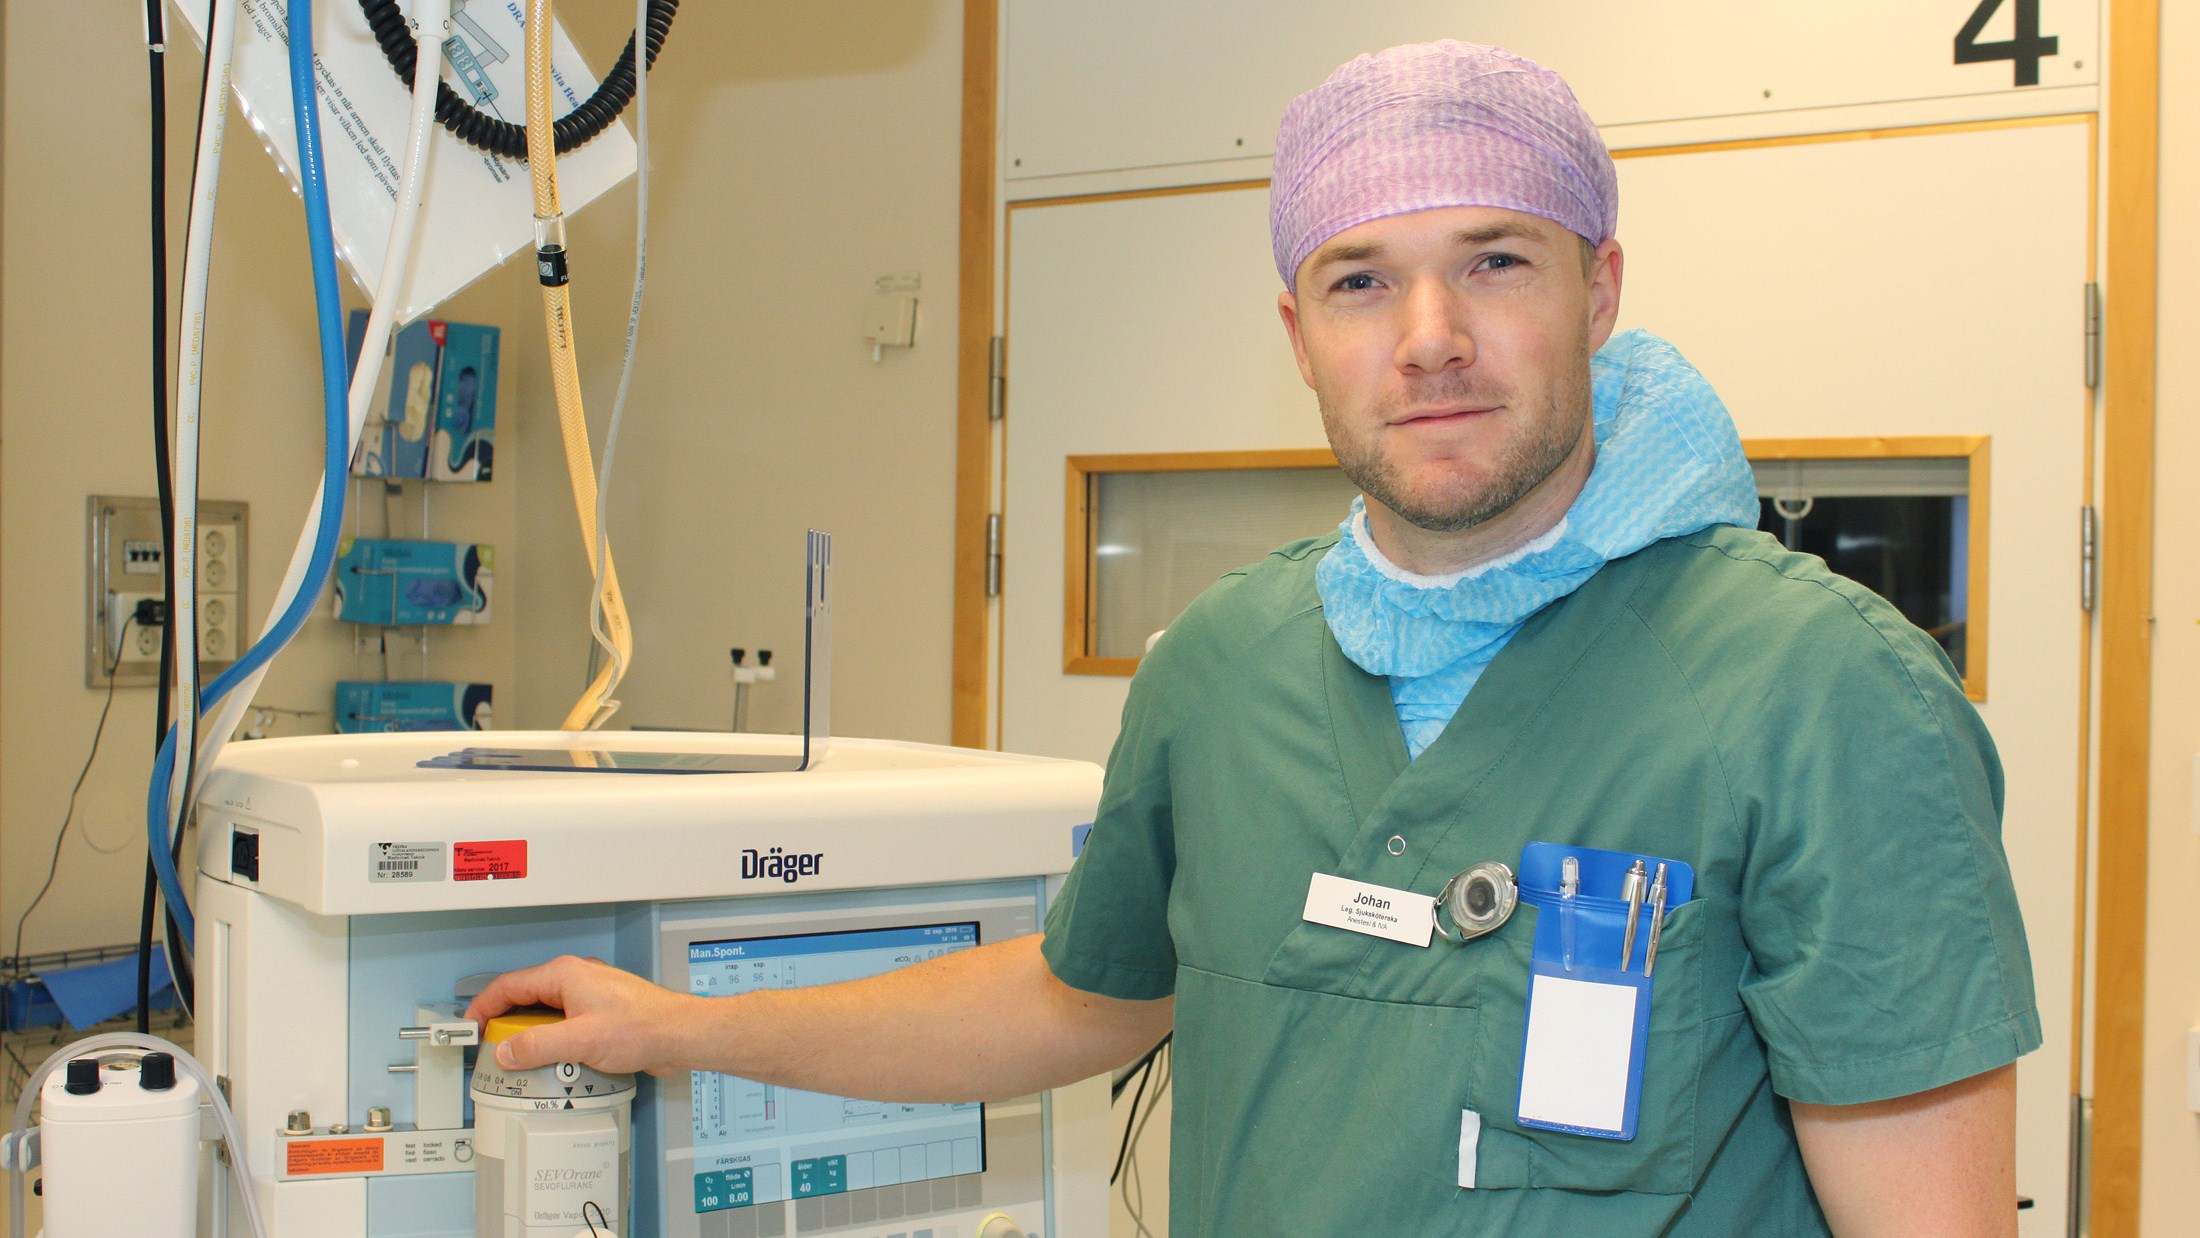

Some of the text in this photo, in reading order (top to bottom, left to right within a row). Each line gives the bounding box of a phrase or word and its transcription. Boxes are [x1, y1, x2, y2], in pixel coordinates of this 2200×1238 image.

[1953, 0, 2059, 87] 4
[314, 58, 337, 88] tryckas
[334, 86, 343, 97] in
[340, 97, 353, 112] när
[350, 111, 370, 137] armen
[368, 136, 385, 156] skall
[381, 155, 401, 182] flyttas
[325, 95, 340, 115] visar
[338, 115, 357, 141] vilken
[355, 140, 367, 155] led
[365, 154, 379, 172] som
[489, 862, 510, 872] 2017
[741, 846, 824, 884] Dräger
[391, 871, 413, 879] 28589
[1353, 892, 1391, 910] Johan
[1341, 905, 1398, 923] Leg. Sjuksköterska
[1347, 916, 1371, 927] Anestesi
[1377, 922, 1388, 930] IVA
[690, 945, 745, 959] Man.Spont.
[728, 974, 740, 985] 96
[753, 972, 764, 983] 96
[494, 1076, 505, 1085] 0.4
[516, 1078, 528, 1087] 0.2
[534, 1181, 593, 1191] SEVOFLURANE
[799, 1182, 811, 1193] 40
[701, 1192, 749, 1207] 100 8.00
